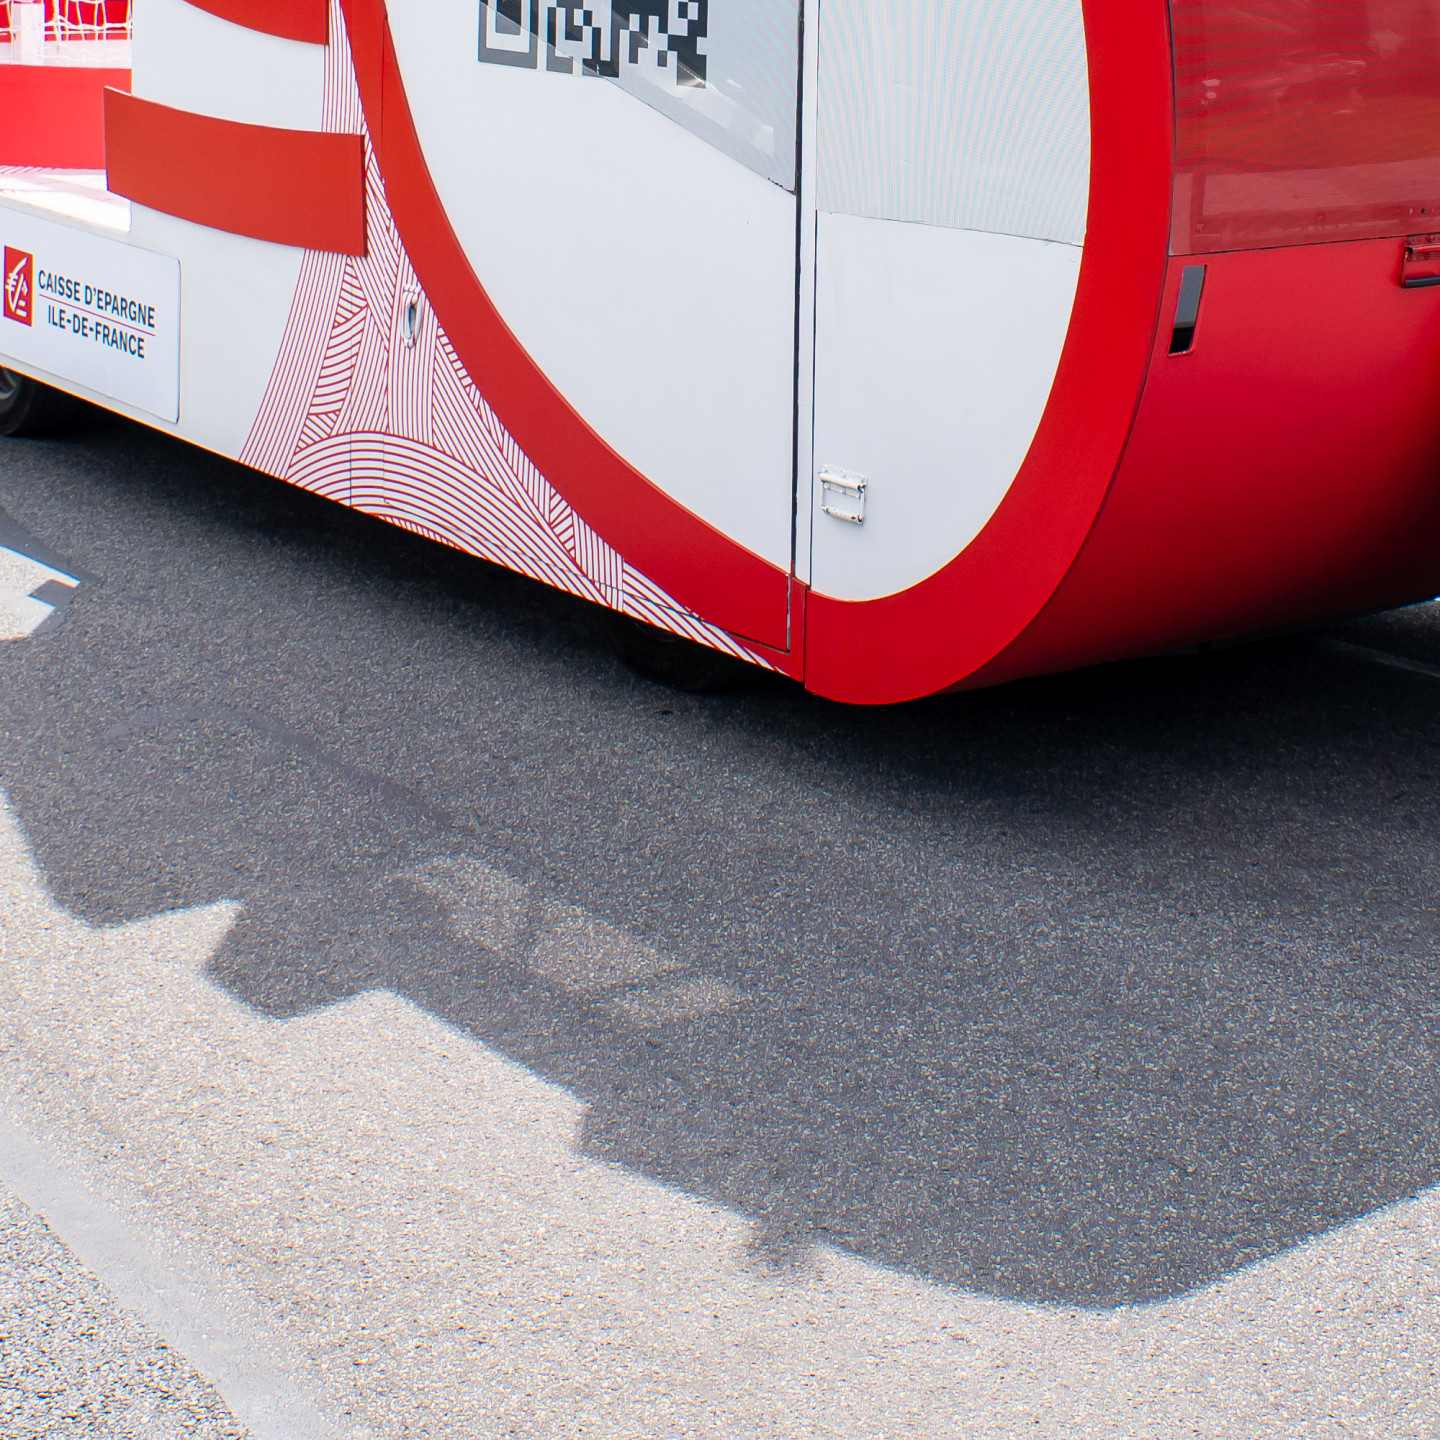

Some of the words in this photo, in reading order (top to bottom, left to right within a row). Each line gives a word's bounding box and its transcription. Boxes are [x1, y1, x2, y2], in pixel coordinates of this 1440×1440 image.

[38, 269, 81, 302] CAISSE
[84, 284, 156, 328] D'EPARGNE
[48, 304, 145, 359] ILE-DE-FRANCE
